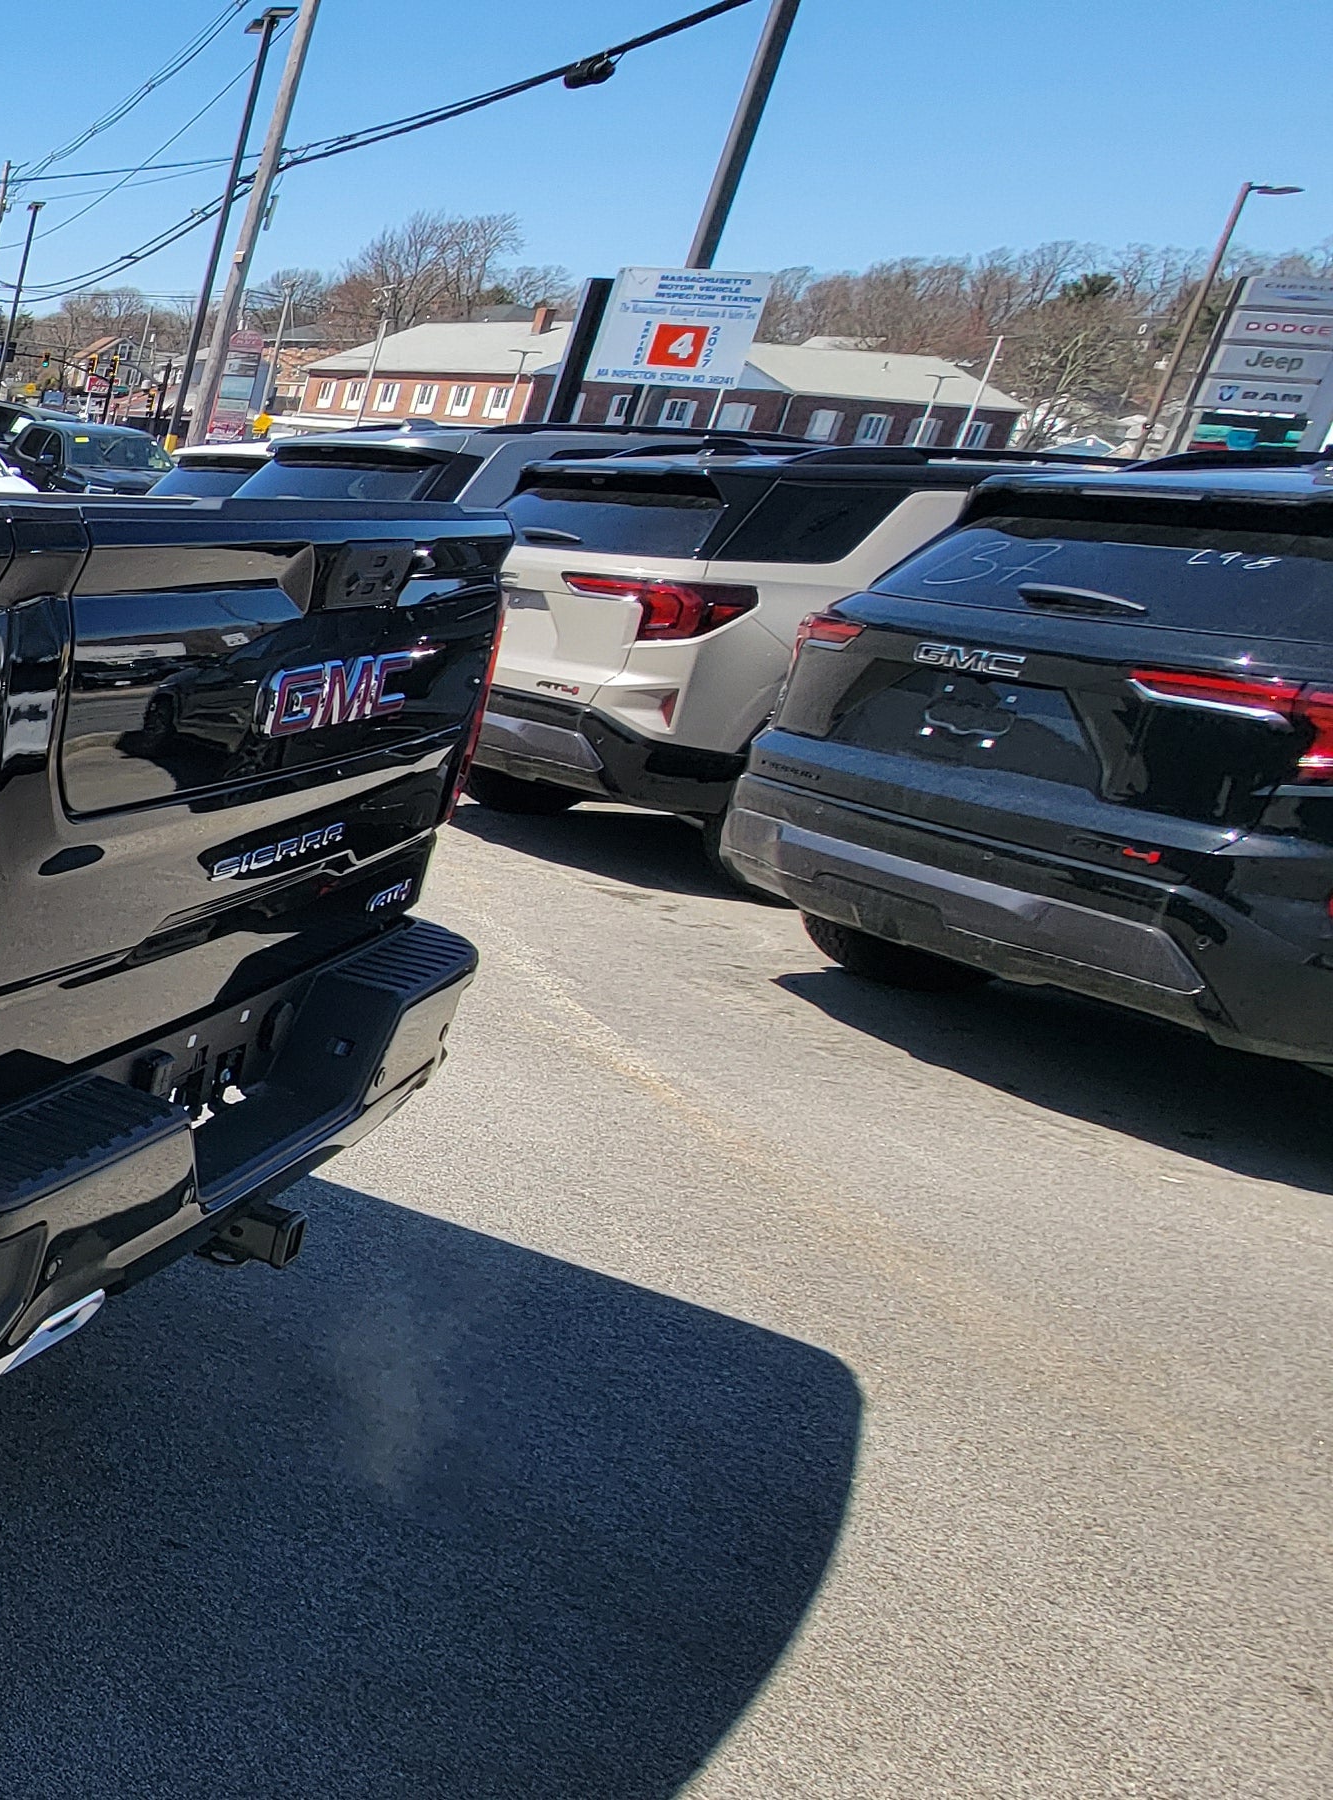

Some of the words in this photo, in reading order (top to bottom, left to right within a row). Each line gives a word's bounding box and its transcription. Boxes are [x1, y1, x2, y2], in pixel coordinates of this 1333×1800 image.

[660, 274, 752, 286] MASSACHUSETTS
[1264, 283, 1333, 291] CHRYSL
[658, 283, 694, 291] MOTOR
[698, 285, 741, 293] VEHICLE
[655, 292, 716, 301] INSPECTION
[721, 295, 762, 303] STATION
[1245, 322, 1332, 336] DODGE
[668, 332, 695, 359] 4
[702, 326, 721, 368] 2027
[1245, 351, 1304, 373] Jeep
[611, 368, 656, 380] INSPECTION
[660, 371, 690, 382] STATION
[1241, 391, 1303, 403] RAM
[913, 641, 1027, 678] GMC
[536, 680, 580, 695] AT4
[257, 652, 413, 739] GMC
[210, 822, 346, 881] SIERRA
